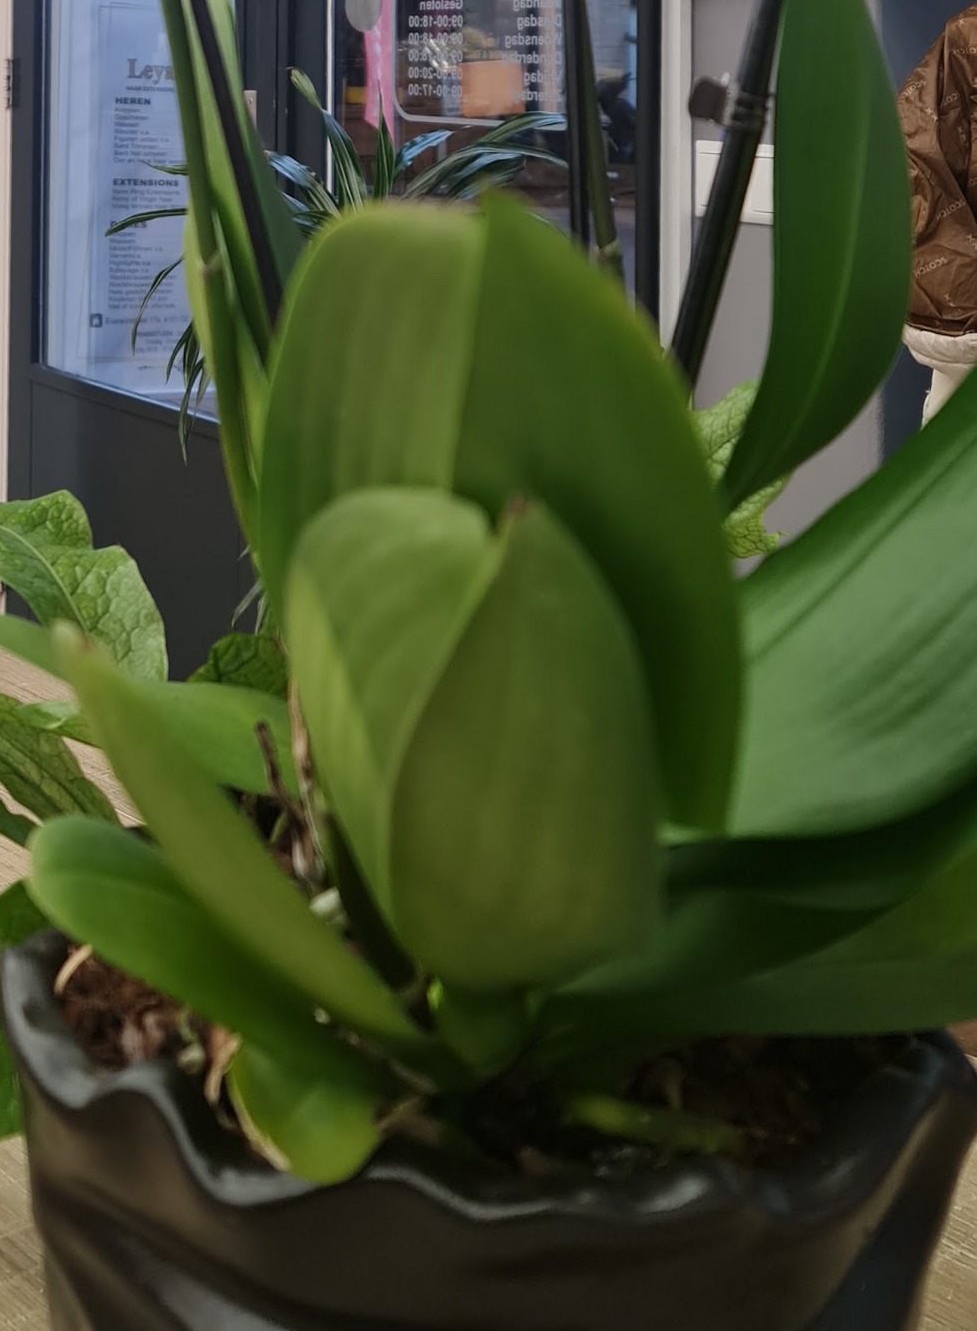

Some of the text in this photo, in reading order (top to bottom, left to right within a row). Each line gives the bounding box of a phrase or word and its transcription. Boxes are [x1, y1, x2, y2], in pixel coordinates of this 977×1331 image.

[127, 58, 175, 84] Leya
[115, 97, 151, 105] HEREN
[113, 178, 180, 186] EXTENSIONS
